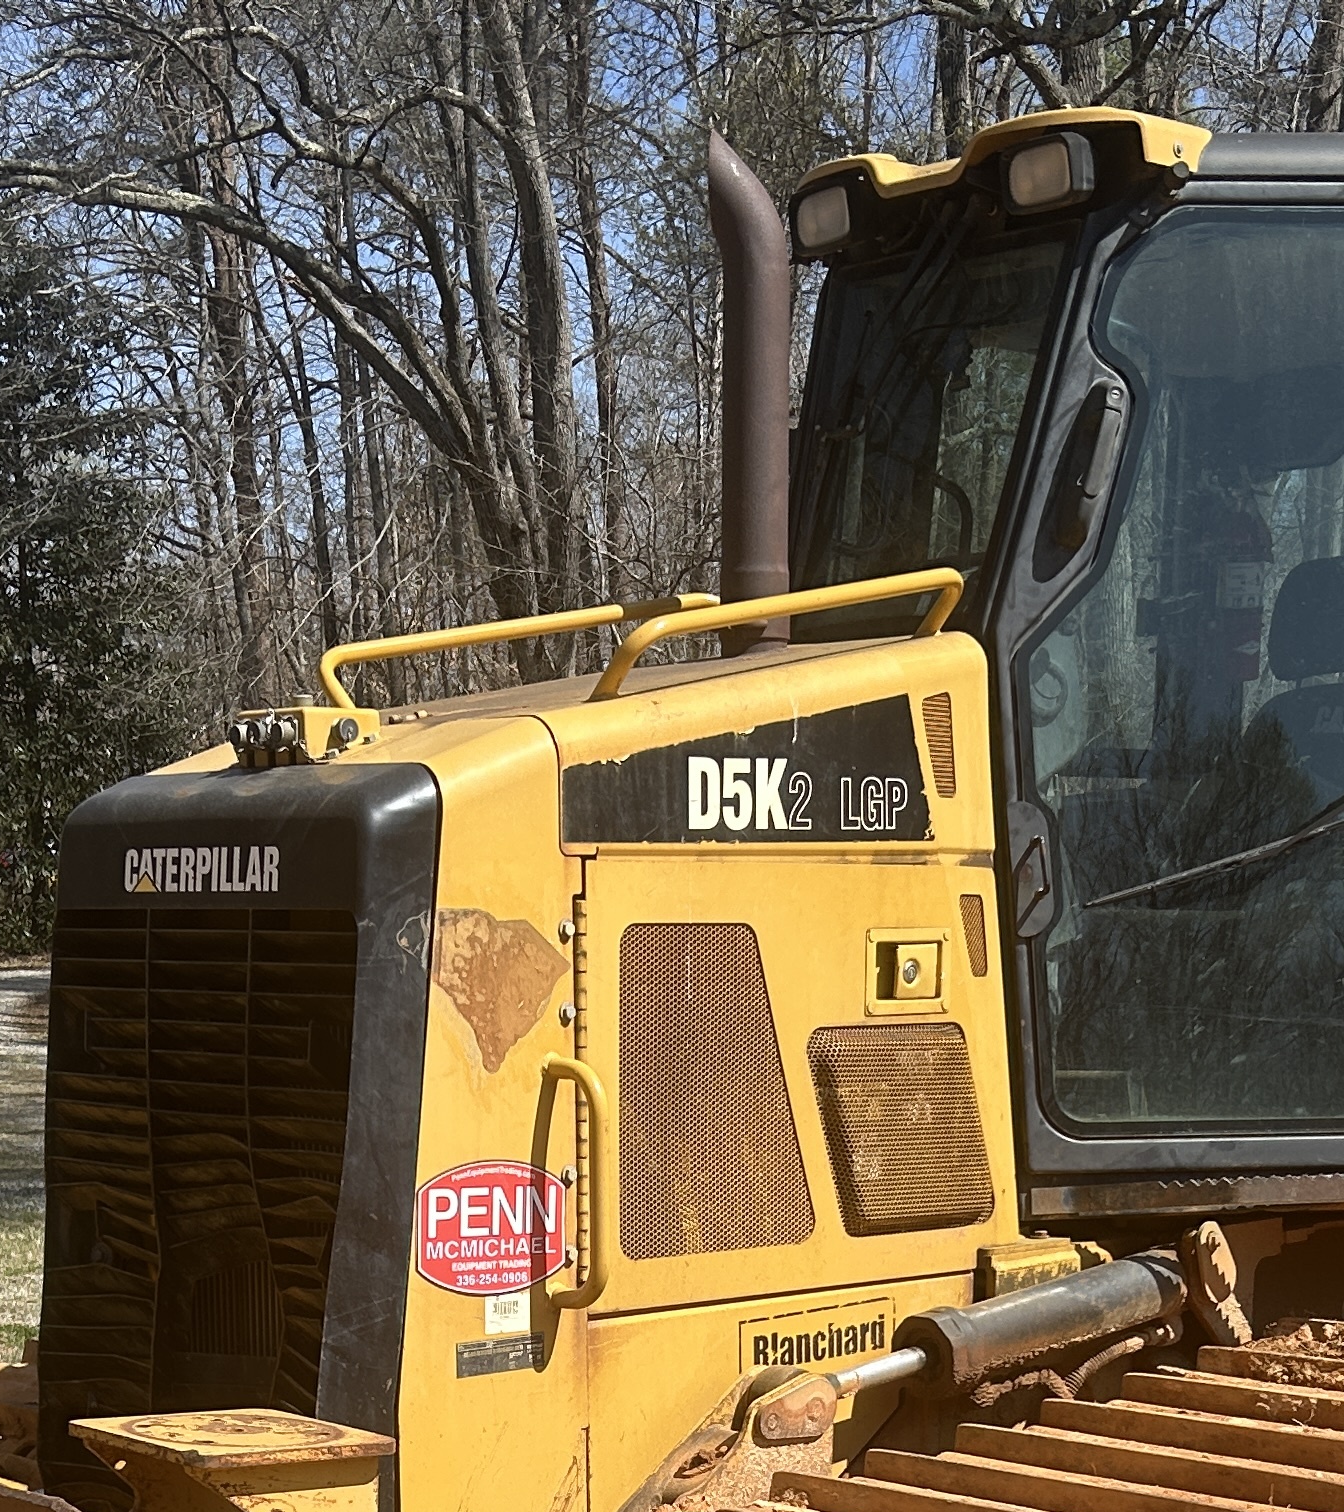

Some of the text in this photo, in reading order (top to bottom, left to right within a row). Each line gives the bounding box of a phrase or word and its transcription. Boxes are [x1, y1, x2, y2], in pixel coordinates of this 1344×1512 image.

[840, 775, 909, 832] LGP
[124, 846, 280, 893] CATERPILLAR
[427, 1184, 557, 1239] PENN
[426, 1236, 557, 1260] MCMICHAEL
[451, 1258, 532, 1272] EQUIPMENT TRADING
[456, 1271, 528, 1286] 336-254-0906
[753, 1313, 885, 1366] Blanchard
